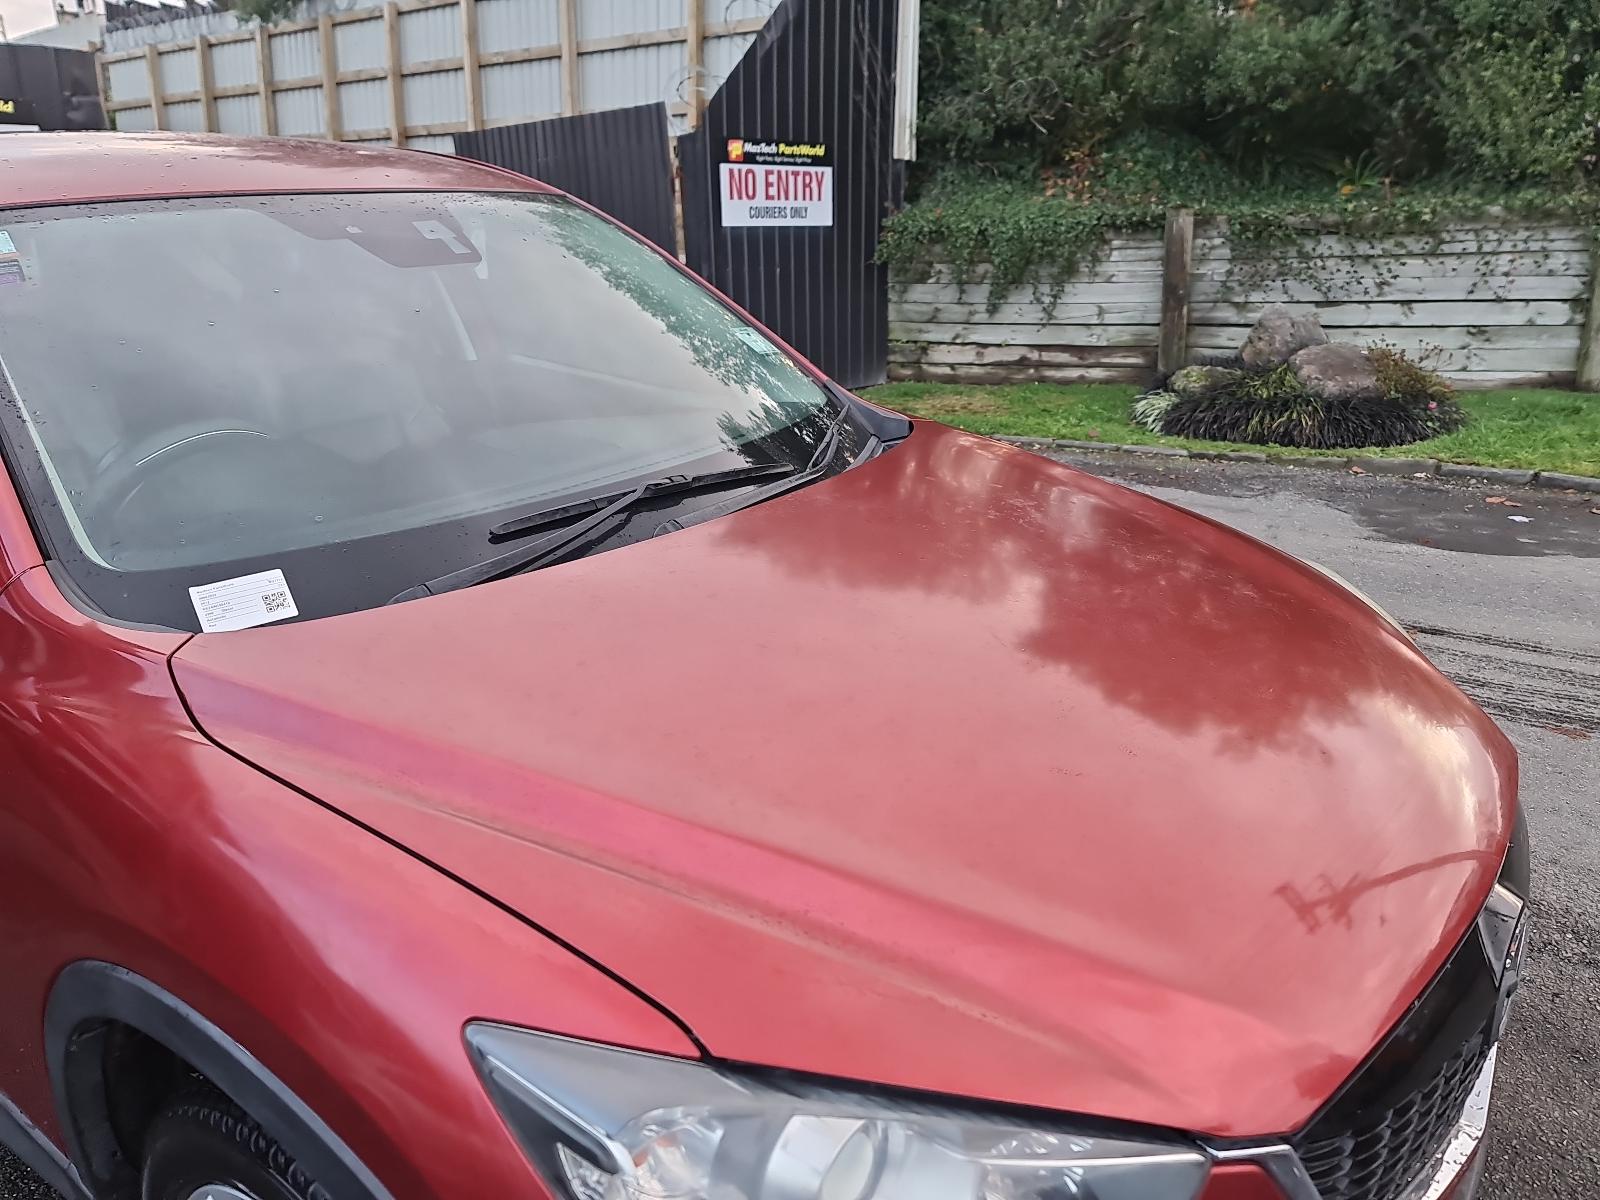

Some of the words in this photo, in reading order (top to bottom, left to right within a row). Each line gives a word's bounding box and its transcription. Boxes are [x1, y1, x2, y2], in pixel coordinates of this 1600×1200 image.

[778, 143, 826, 157] PartsWorld
[728, 168, 757, 201] NO
[764, 169, 825, 201] ENTRY
[749, 206, 788, 219] COURIERS
[790, 206, 808, 219] ONLY
